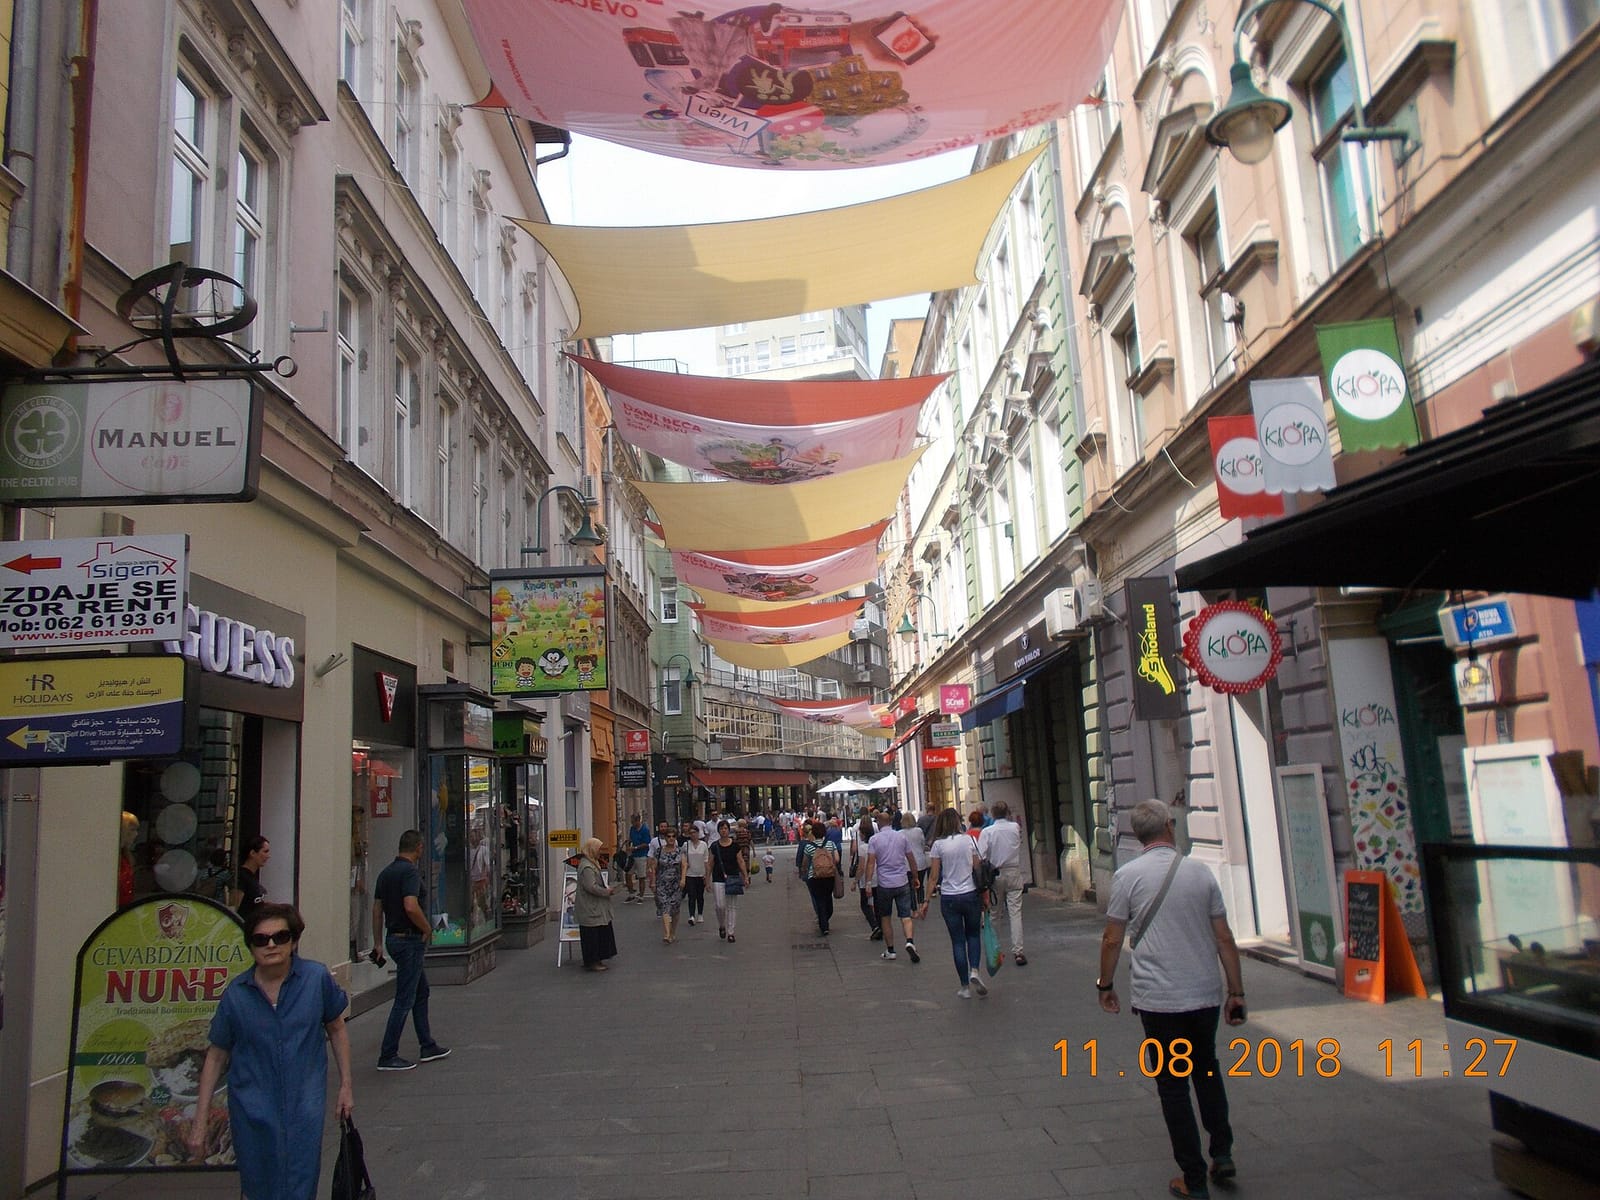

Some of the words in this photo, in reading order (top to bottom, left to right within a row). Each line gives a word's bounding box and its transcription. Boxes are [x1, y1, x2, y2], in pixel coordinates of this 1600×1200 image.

[698, 104, 750, 132] Wien
[31, 398, 58, 407] CELTIC
[99, 426, 236, 449] MANUEL
[17, 451, 63, 467] SARAJEVO
[0, 478, 18, 489] THE
[21, 476, 55, 488] CELTIC
[57, 476, 78, 487] PUB
[0, 582, 119, 603] ZDAJE
[132, 579, 177, 597] SE
[78, 596, 177, 614] RENT
[45, 616, 84, 631] 062
[91, 614, 115, 629] 61
[122, 612, 147, 627] 93
[153, 611, 176, 626] 61
[12, 627, 155, 641] www.sigenx.com
[1142, 604, 1159, 674] Shoeland
[13, 693, 73, 705] HOLIDAYS
[140, 716, 160, 726] رحلات
[97, 729, 116, 737] Tours
[92, 942, 245, 966] ĆEVABDŽINICA
[105, 967, 229, 1004] NUNE
